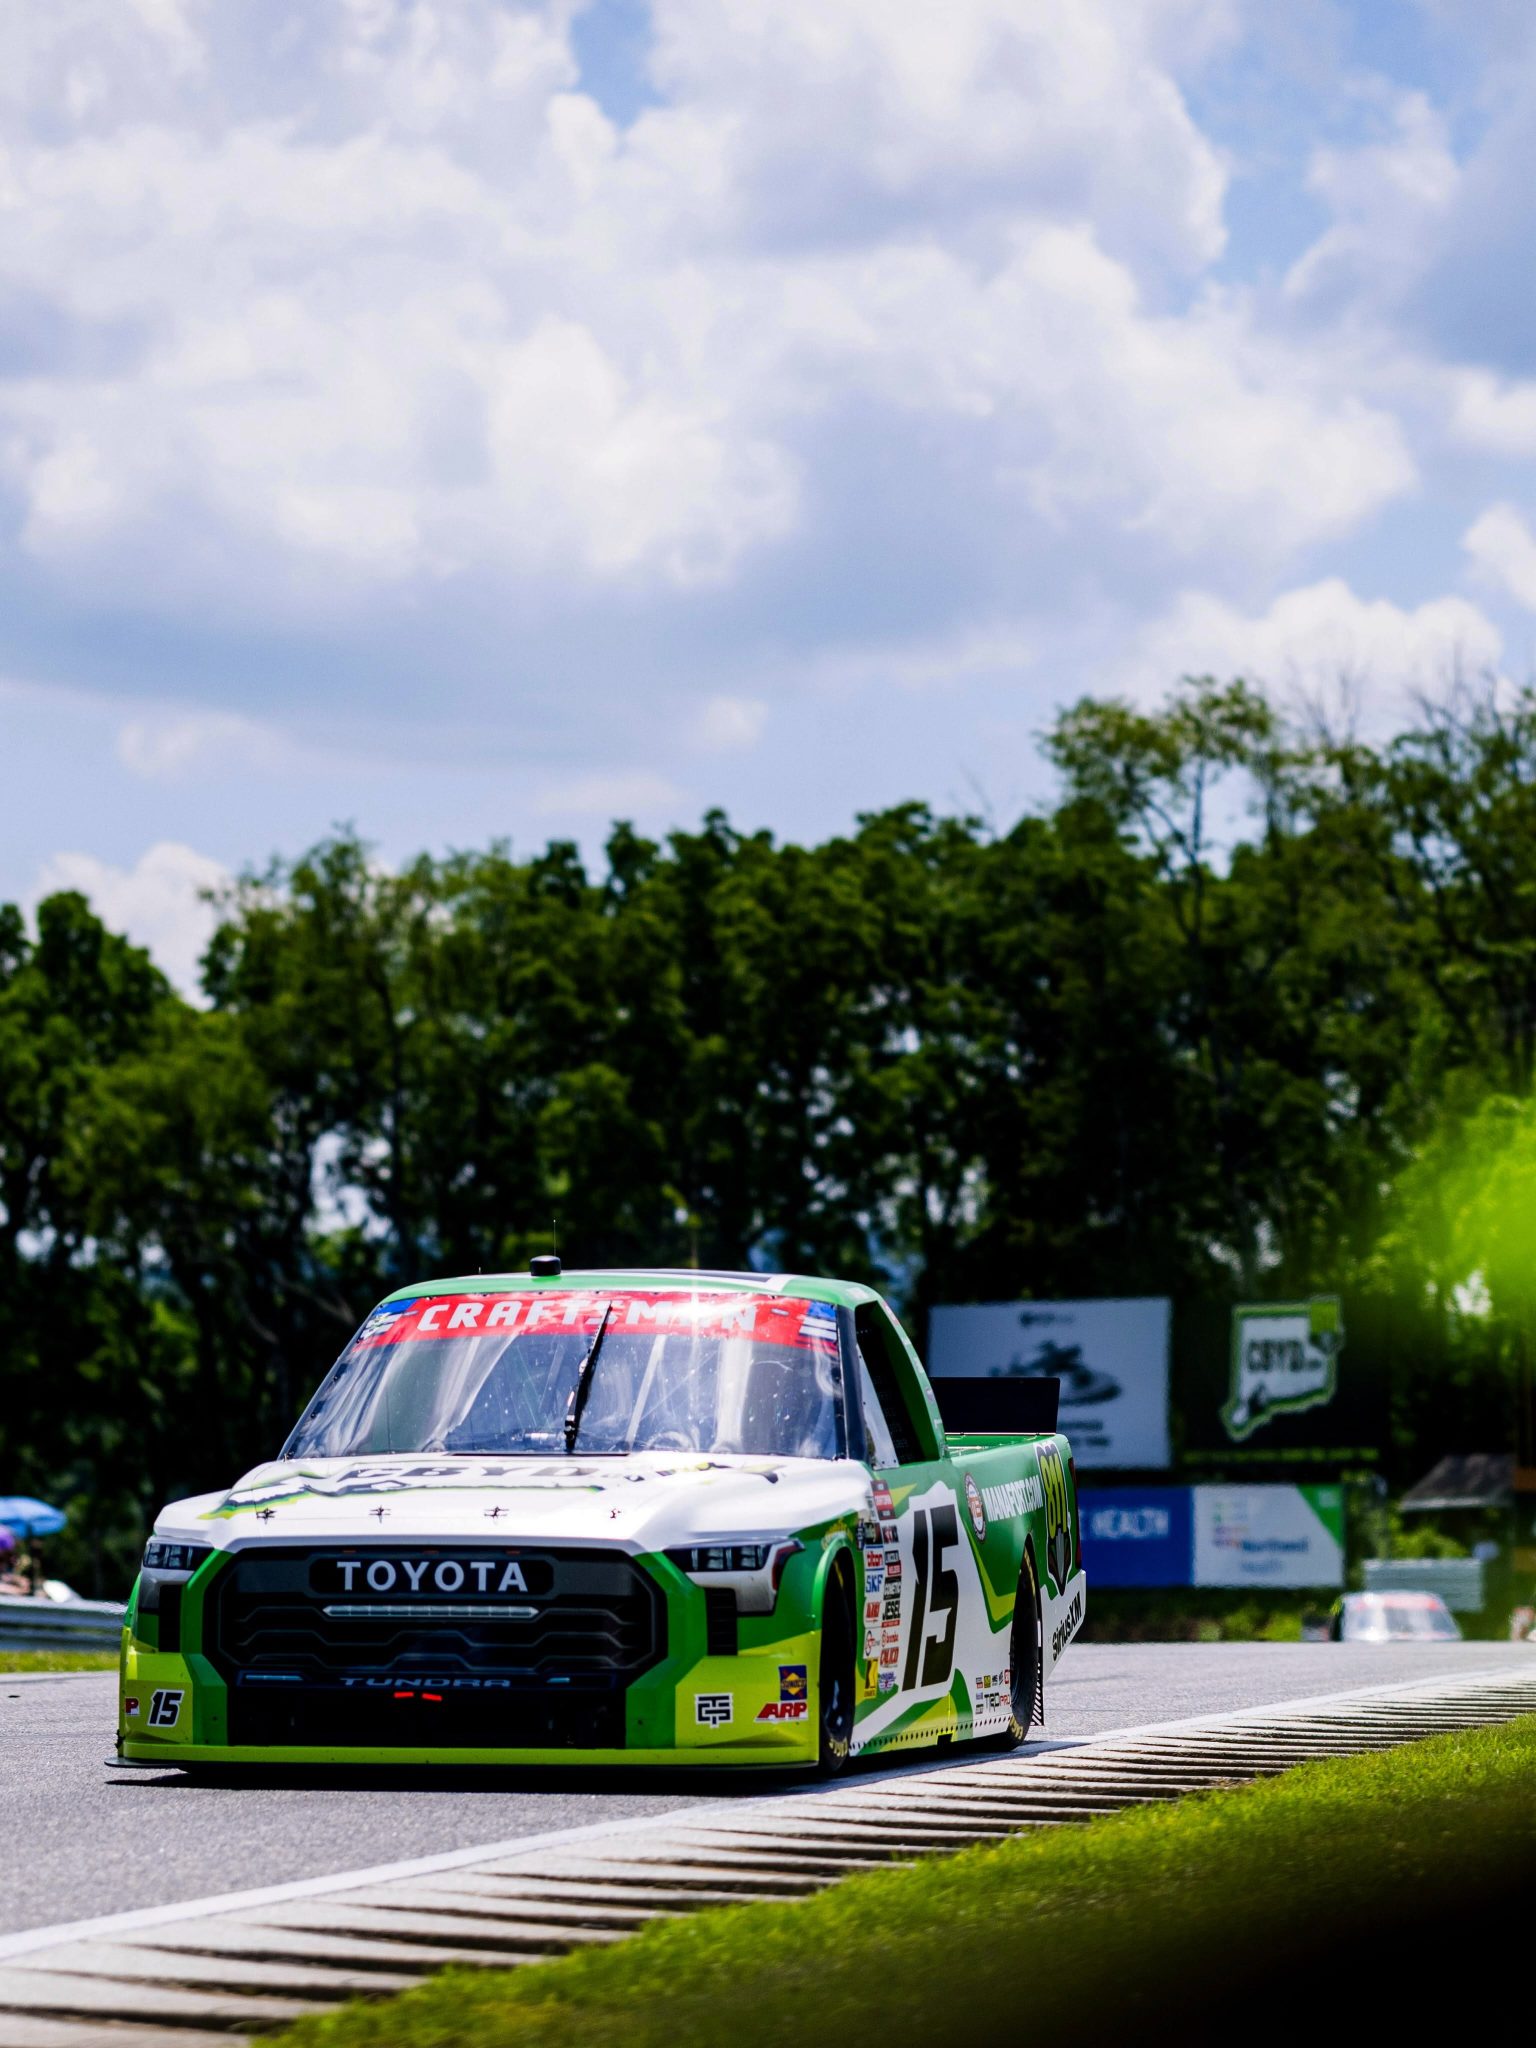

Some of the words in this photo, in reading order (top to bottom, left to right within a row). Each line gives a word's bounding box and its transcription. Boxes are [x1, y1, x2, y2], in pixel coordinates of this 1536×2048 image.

[1248, 1339, 1322, 1373] CBYD.
[981, 1474, 1044, 1522] MANAFORT.COM
[1041, 1453, 1068, 1539] 811
[336, 1560, 528, 1592] TOYOTA
[865, 1573, 884, 1593] SKF
[902, 1504, 959, 1692] 15
[340, 1678, 511, 1687] TUNDRA
[147, 1690, 184, 1726] 15
[757, 1701, 808, 1719] ARP
